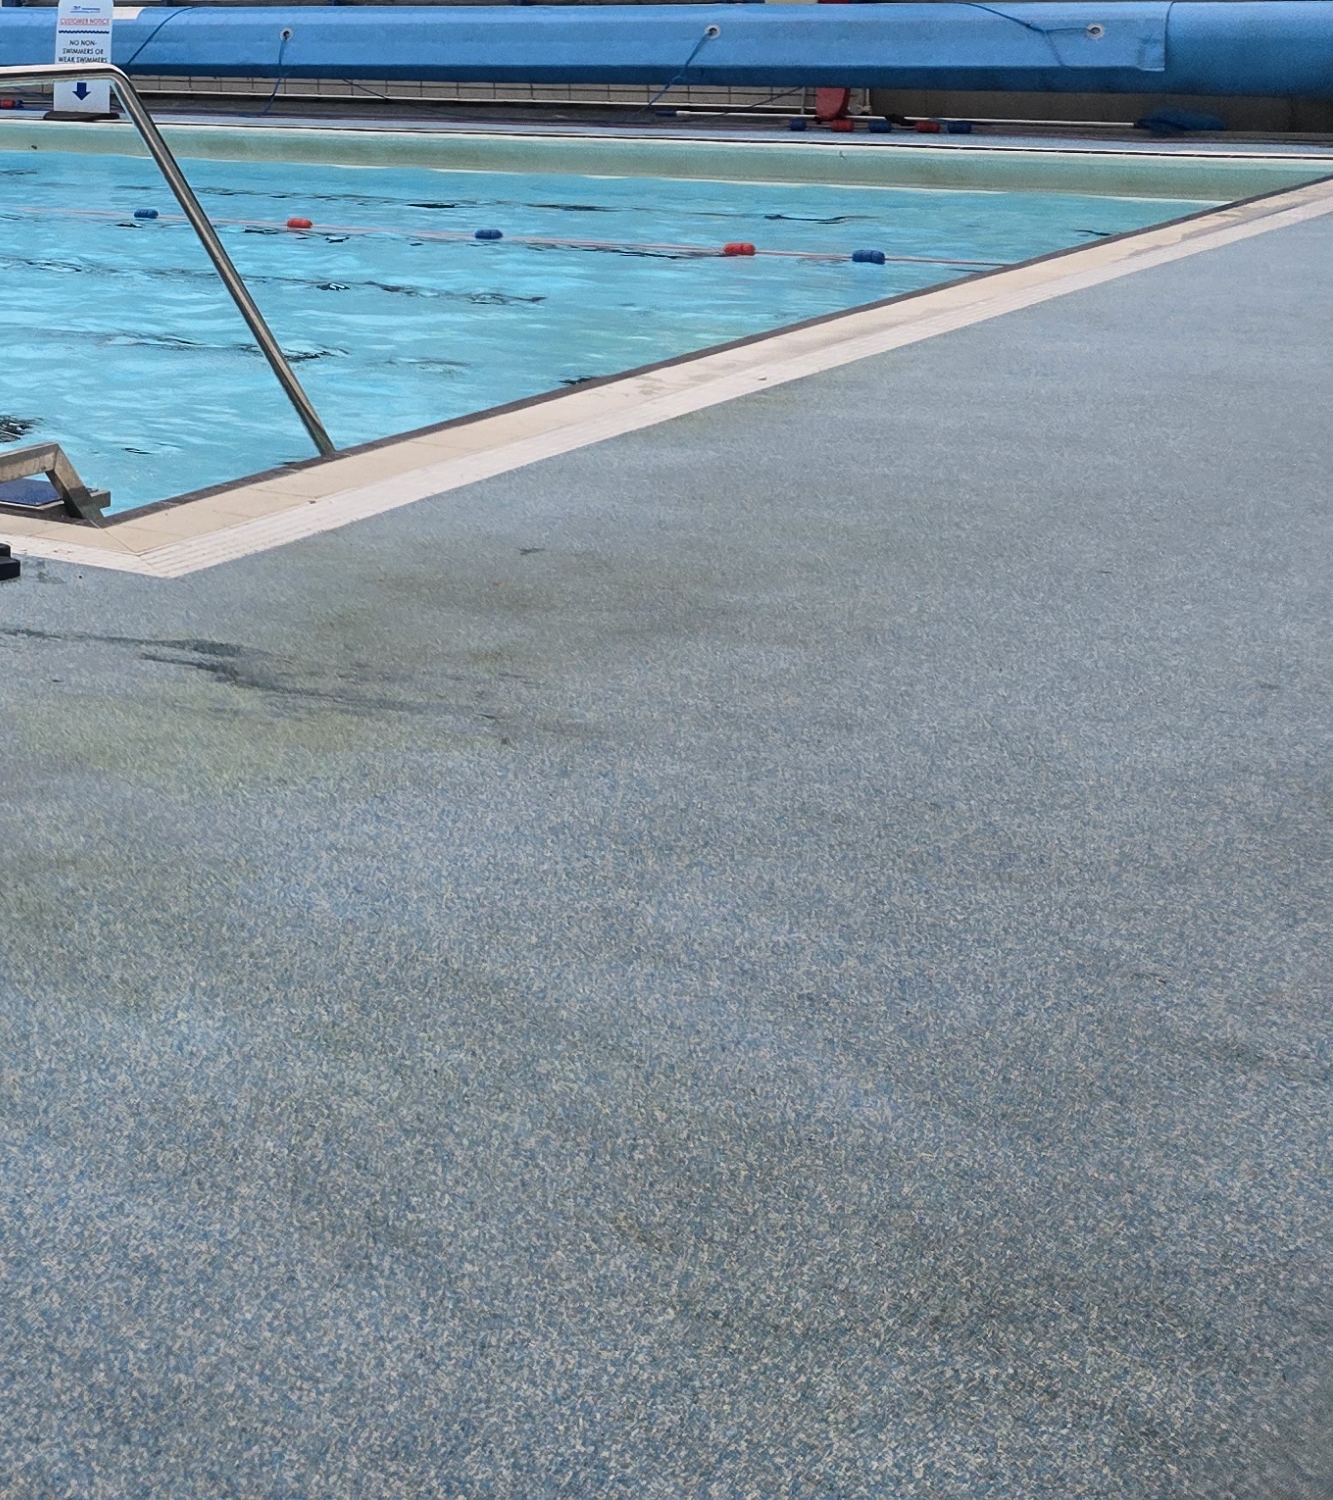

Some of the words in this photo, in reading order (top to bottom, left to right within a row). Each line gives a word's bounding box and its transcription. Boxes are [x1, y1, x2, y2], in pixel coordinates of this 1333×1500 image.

[89, 18, 110, 26] NOTICE
[62, 47, 93, 55] SWIMMERS
[76, 56, 108, 64] SWIMMERS
